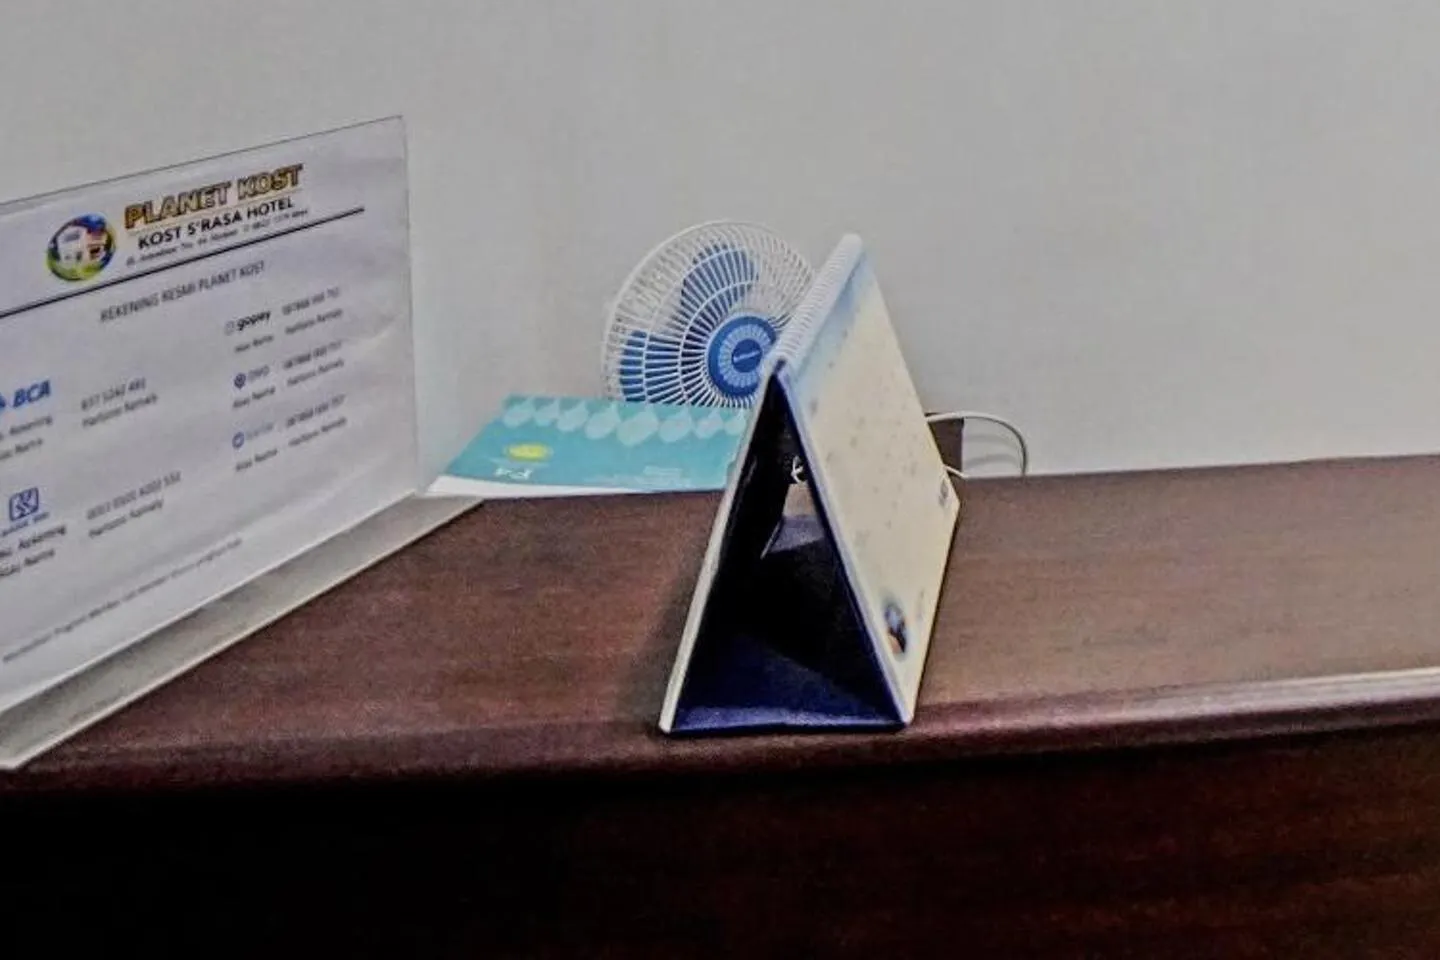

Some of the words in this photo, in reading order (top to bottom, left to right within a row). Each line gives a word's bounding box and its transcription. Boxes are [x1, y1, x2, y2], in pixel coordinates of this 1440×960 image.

[124, 181, 233, 230] PLANET
[235, 162, 304, 201] KOST
[137, 225, 182, 250] KOST
[186, 209, 243, 236] S'RASA
[246, 196, 295, 220] HOTEL
[12, 379, 51, 409] BCA
